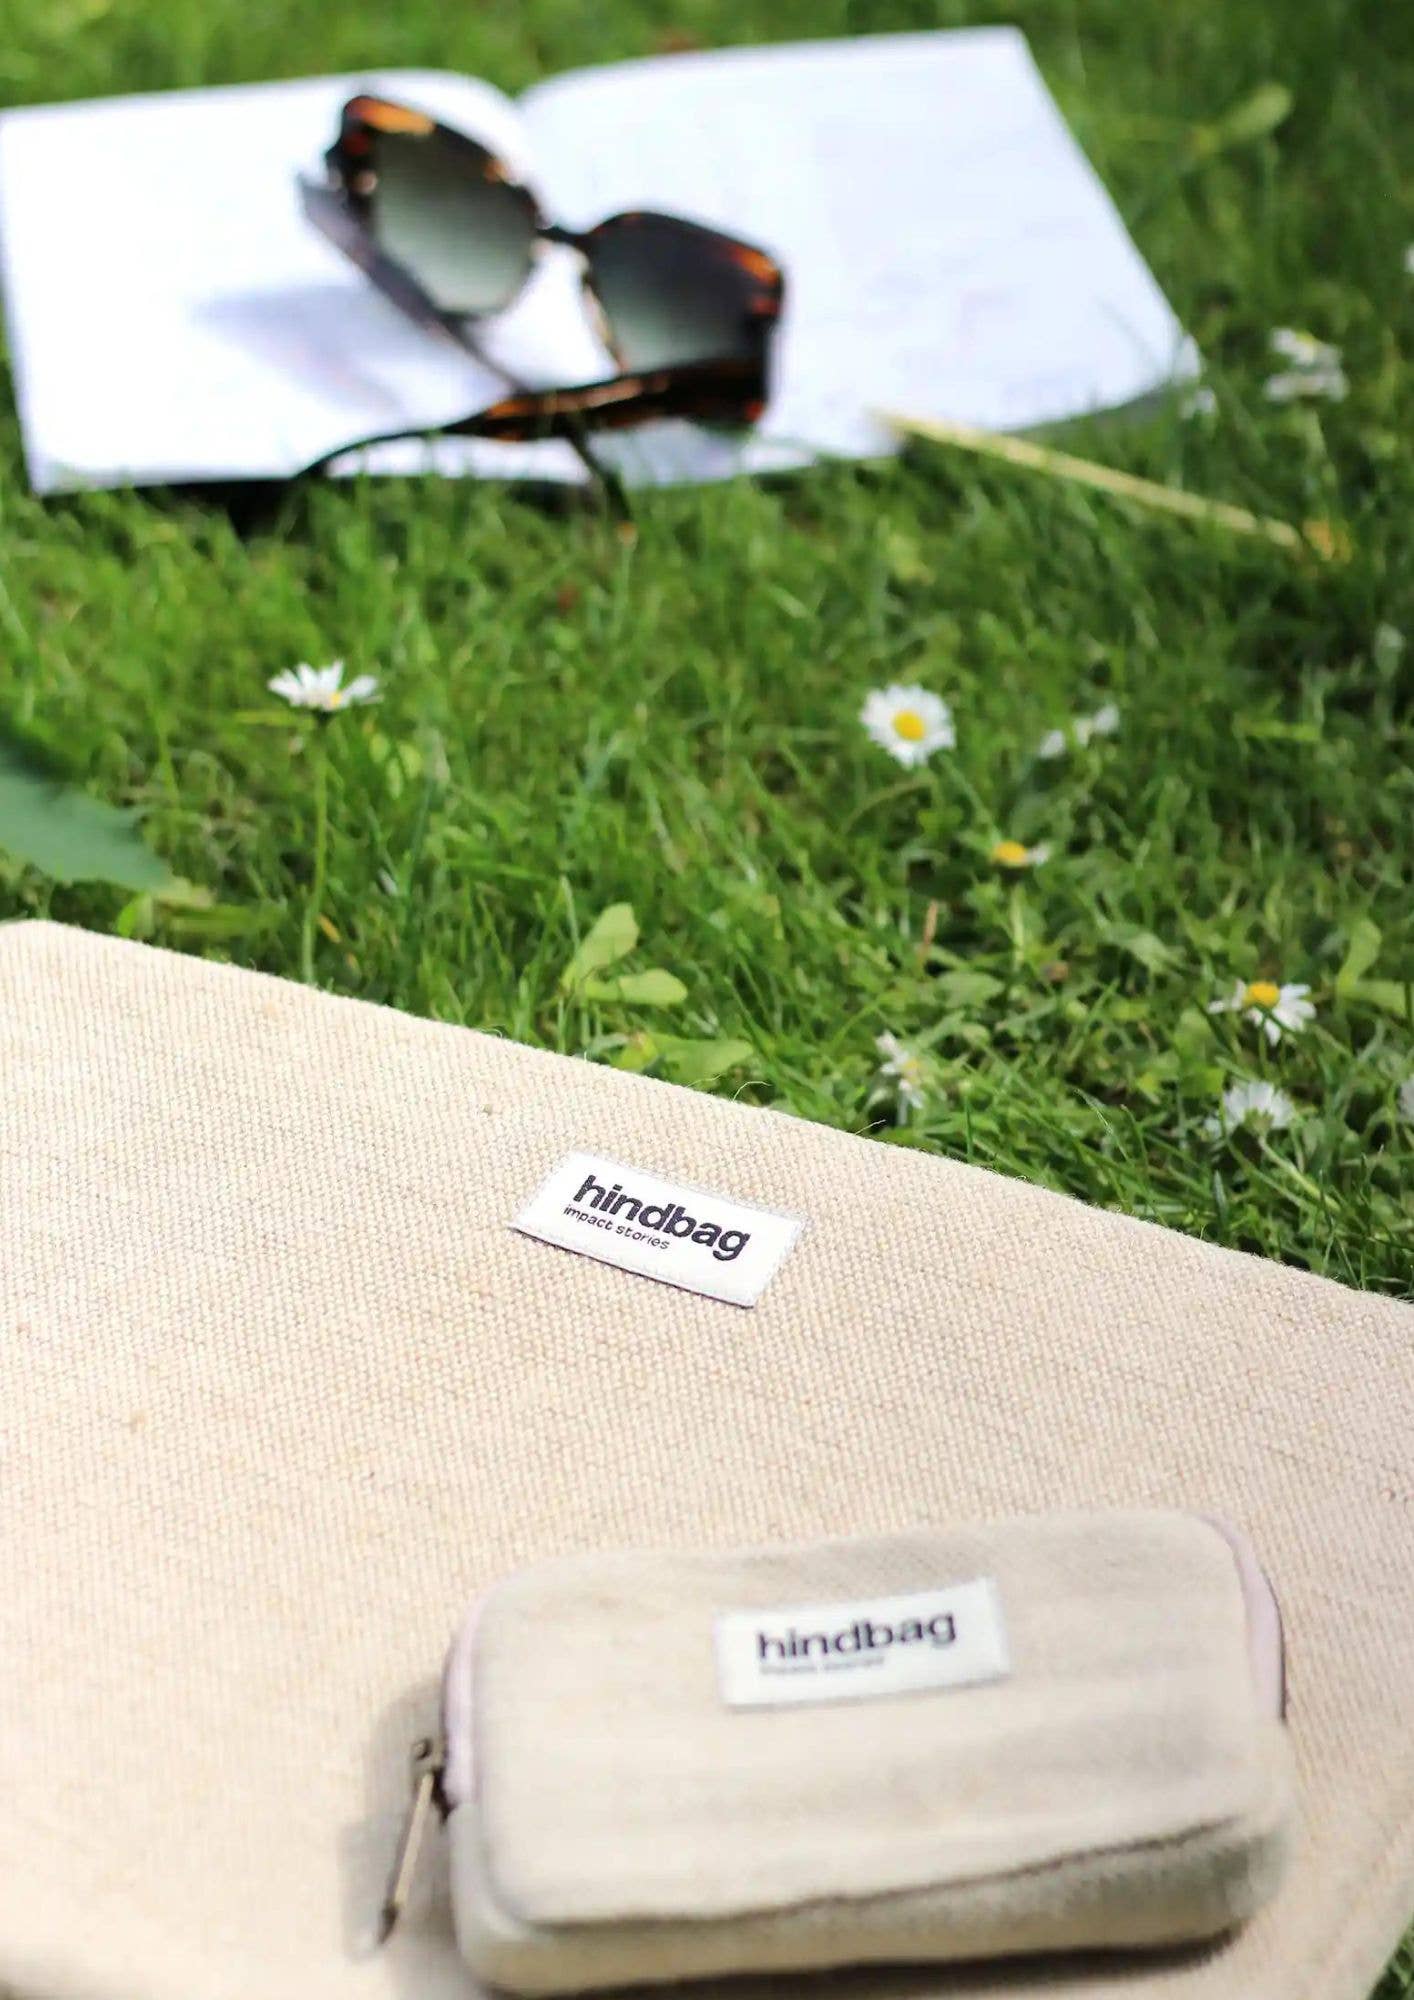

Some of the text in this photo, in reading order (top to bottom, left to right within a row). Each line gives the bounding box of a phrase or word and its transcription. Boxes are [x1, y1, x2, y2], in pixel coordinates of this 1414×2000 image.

[562, 1204, 671, 1251] impact stories
[572, 1174, 751, 1262] hindbag
[756, 1611, 957, 1660] hindbag
